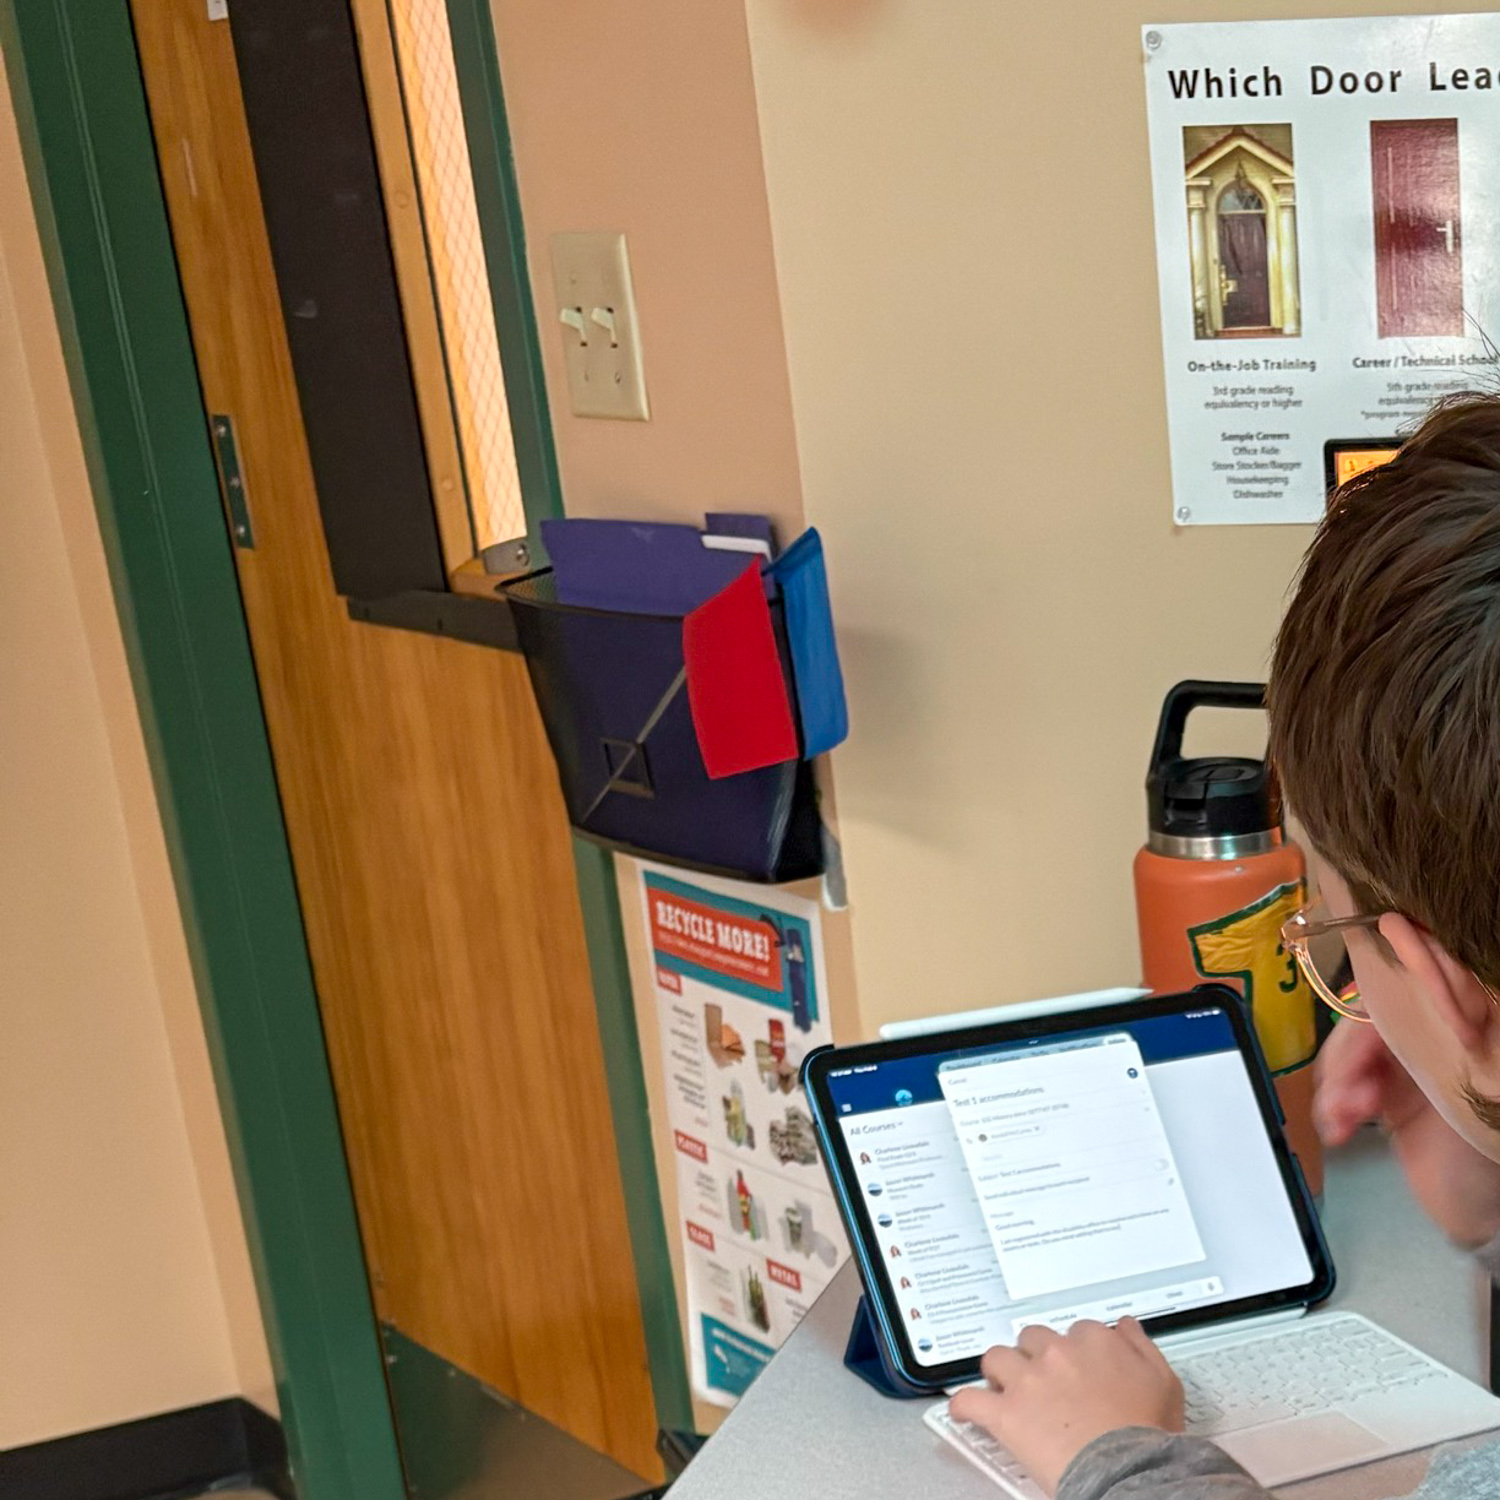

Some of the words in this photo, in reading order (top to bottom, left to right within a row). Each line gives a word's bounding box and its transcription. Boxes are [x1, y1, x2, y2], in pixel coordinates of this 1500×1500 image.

[1168, 66, 1281, 99] Which
[1310, 63, 1401, 94] Door
[1187, 360, 1260, 371] On-the-Job
[1263, 358, 1316, 371] Training
[1352, 357, 1391, 368] Career
[1393, 356, 1398, 368] /
[1401, 355, 1456, 366] Technical
[656, 901, 715, 946] RECYCLE
[716, 922, 770, 962] MORE!
[863, 1121, 896, 1134] Courses
